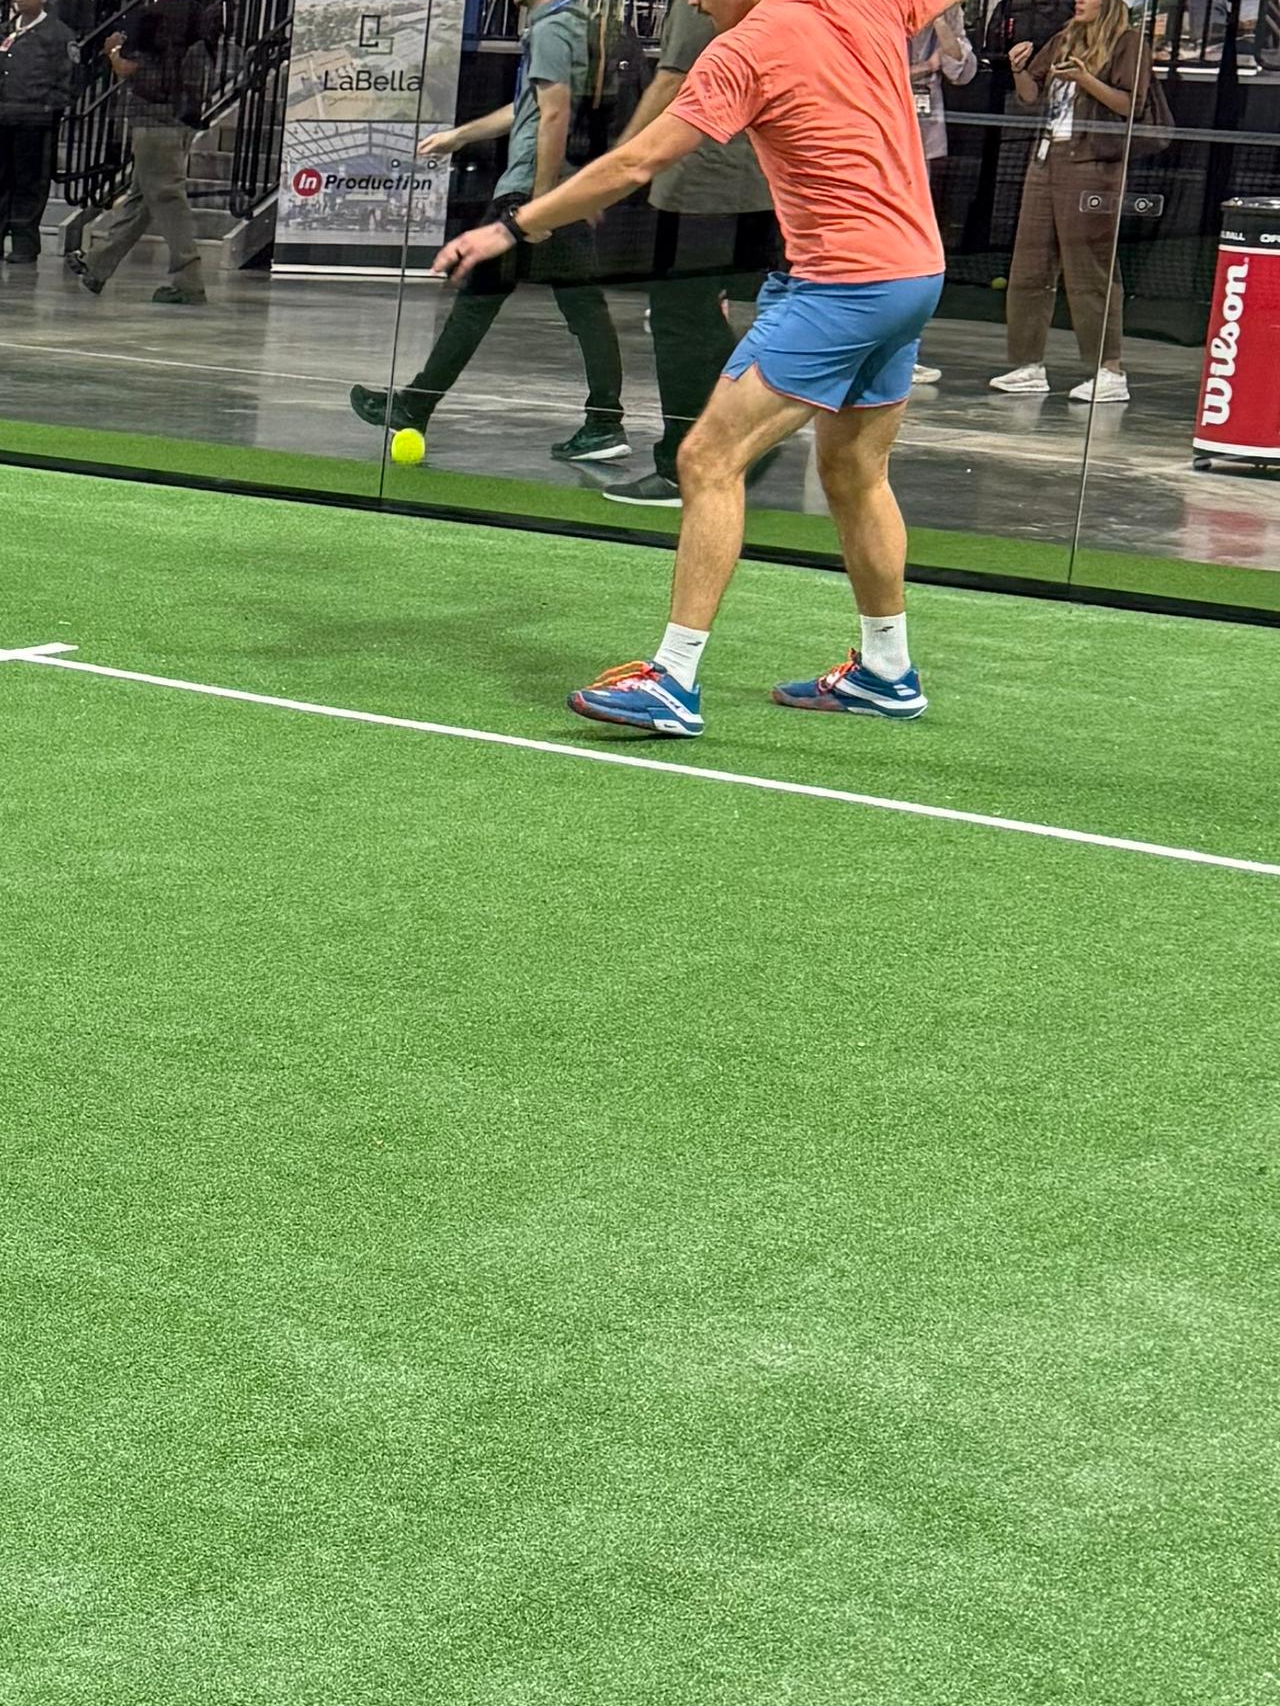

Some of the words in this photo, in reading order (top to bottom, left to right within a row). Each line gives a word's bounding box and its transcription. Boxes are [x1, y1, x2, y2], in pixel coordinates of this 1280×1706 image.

[323, 70, 423, 92] LaBella
[298, 173, 318, 190] In
[323, 173, 433, 191] Production
[1200, 259, 1250, 427] Wilson
